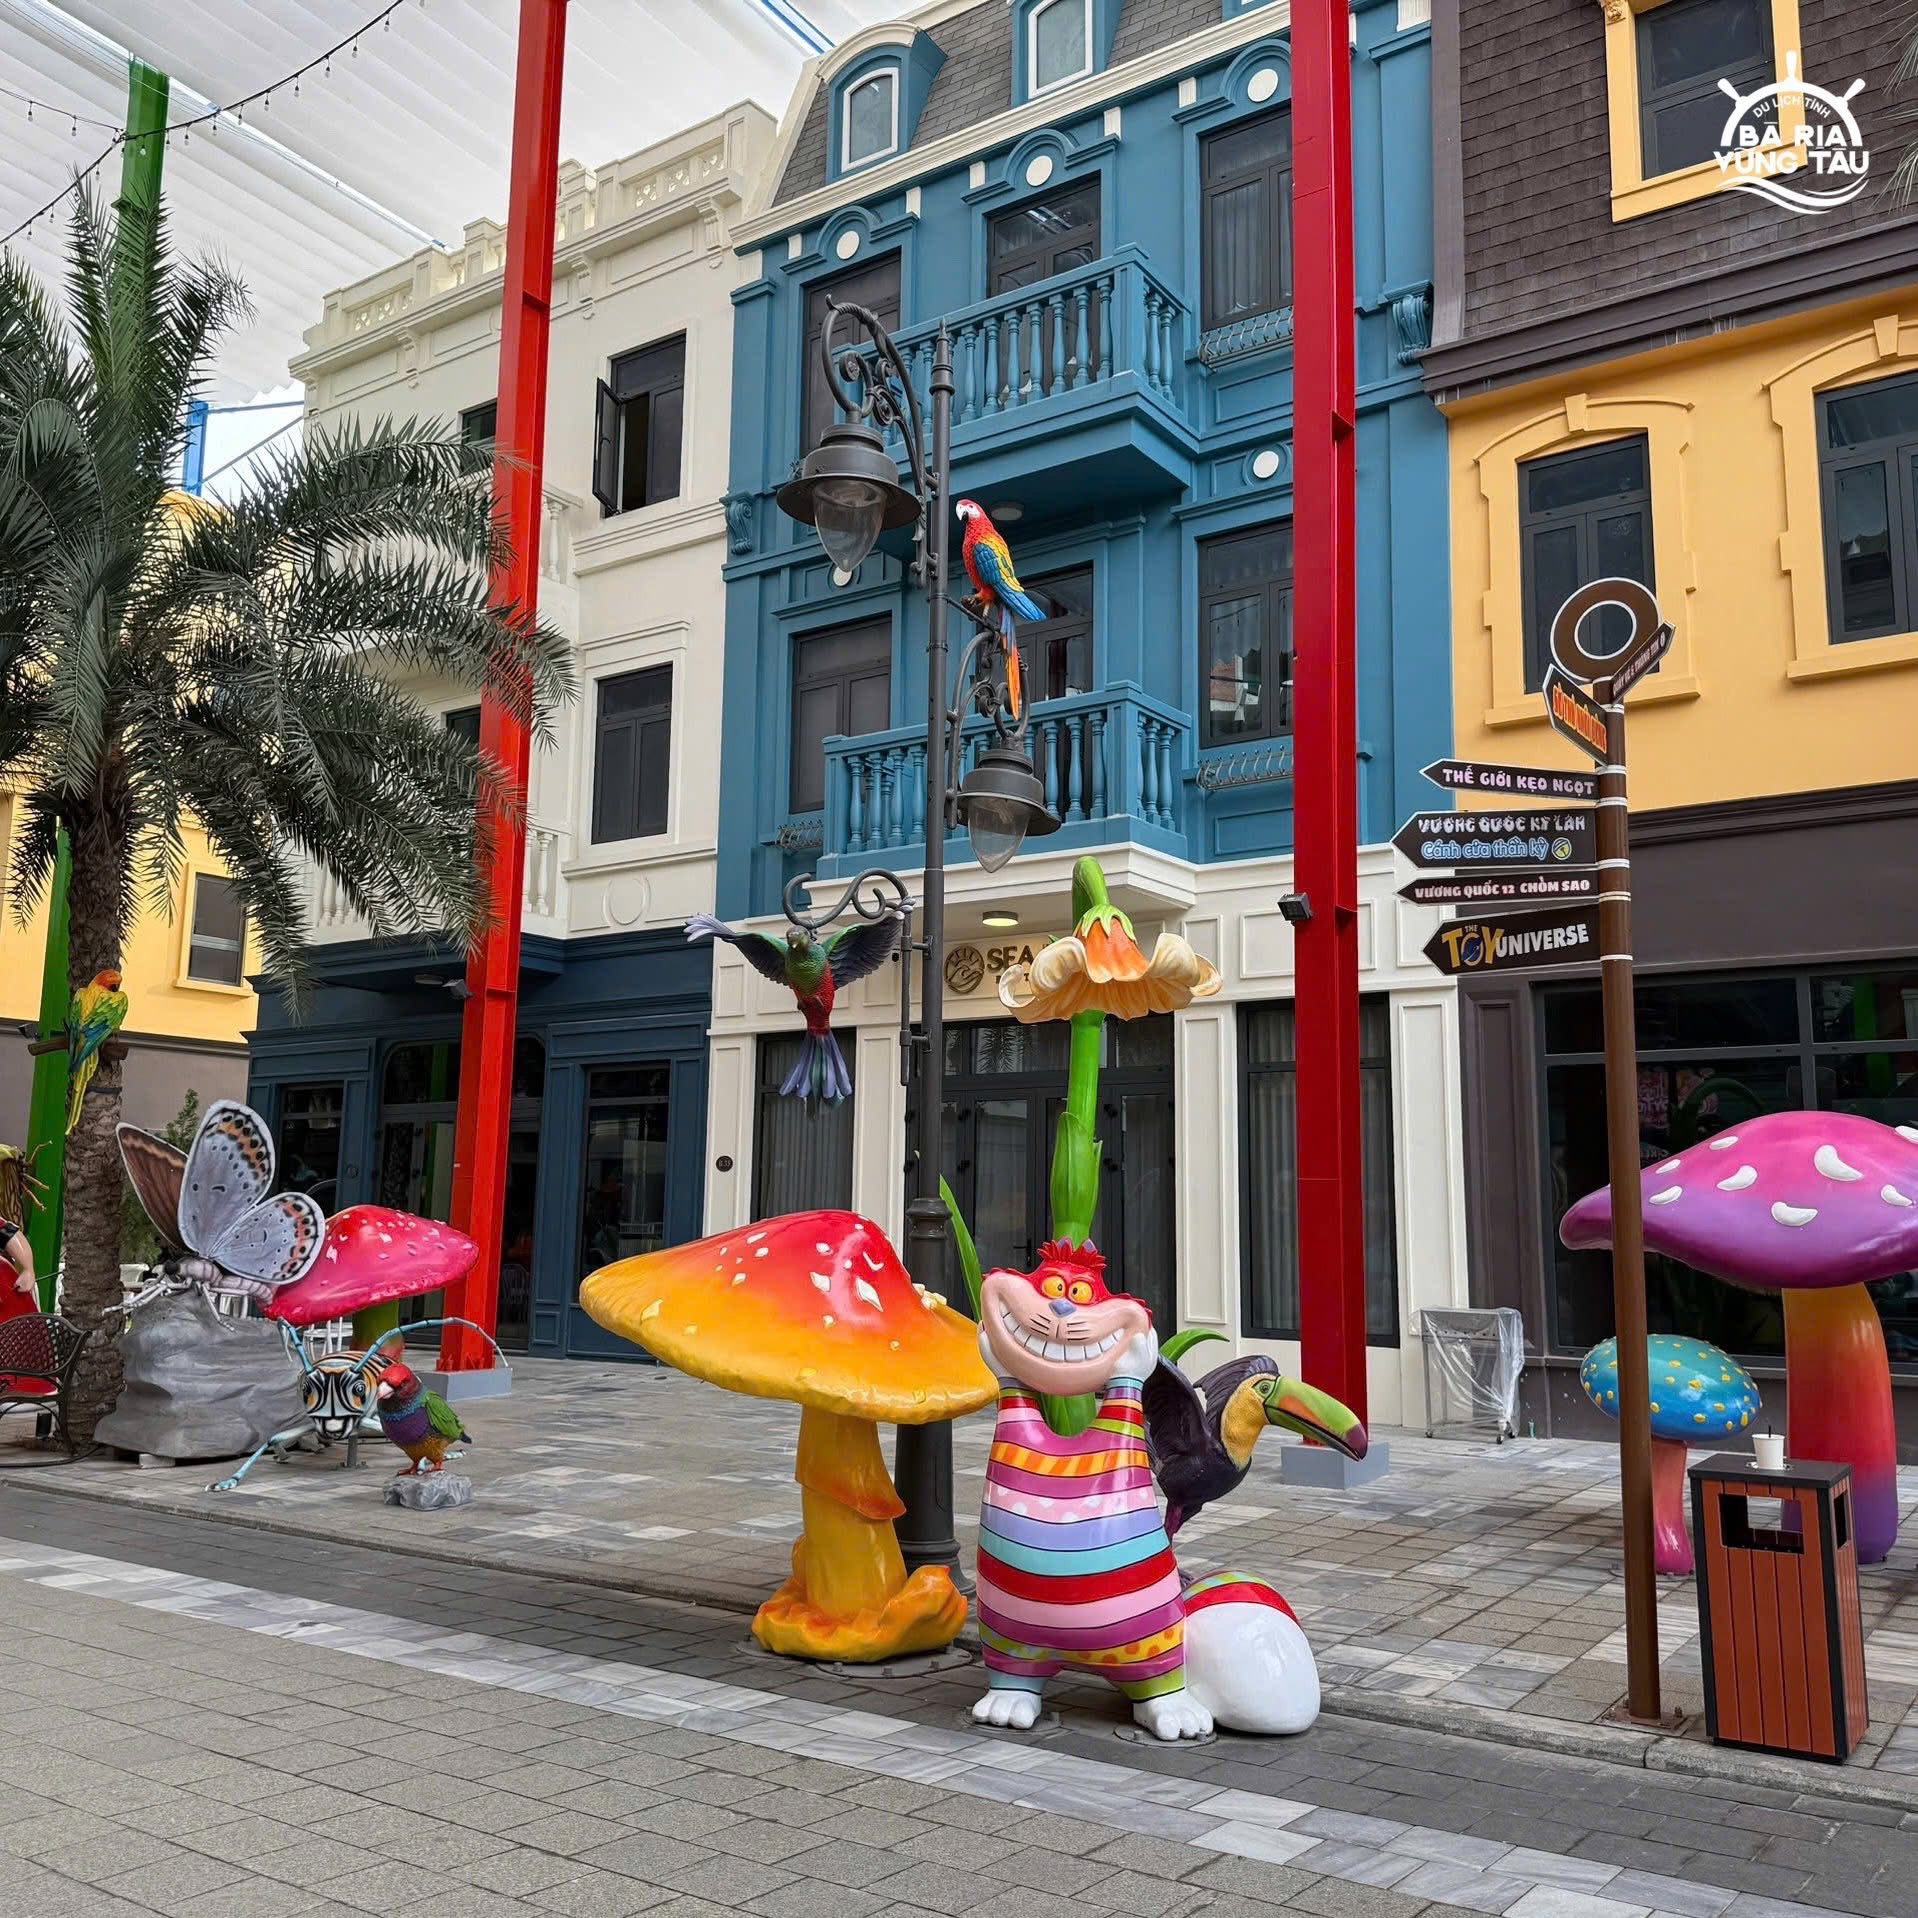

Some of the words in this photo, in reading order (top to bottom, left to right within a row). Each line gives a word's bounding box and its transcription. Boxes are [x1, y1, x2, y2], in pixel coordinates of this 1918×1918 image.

[1442, 764, 1474, 784] THẾ
[1479, 770, 1511, 788] GIỚI
[1516, 776, 1547, 792] KẸO
[1552, 777, 1595, 796] NGỌT
[1420, 838, 1461, 860] Cánh
[1462, 838, 1492, 858] cửa
[1493, 836, 1528, 858] thần
[1415, 884, 1462, 898] VƯƠNG
[1464, 880, 1500, 898] QUỐC
[1502, 886, 1515, 894] 12
[1520, 876, 1558, 894] CHÒM
[1561, 880, 1590, 892] SAO
[1464, 925, 1478, 933] THE
[1441, 926, 1504, 968] TOY
[1495, 924, 1590, 958] UNIVERSE
